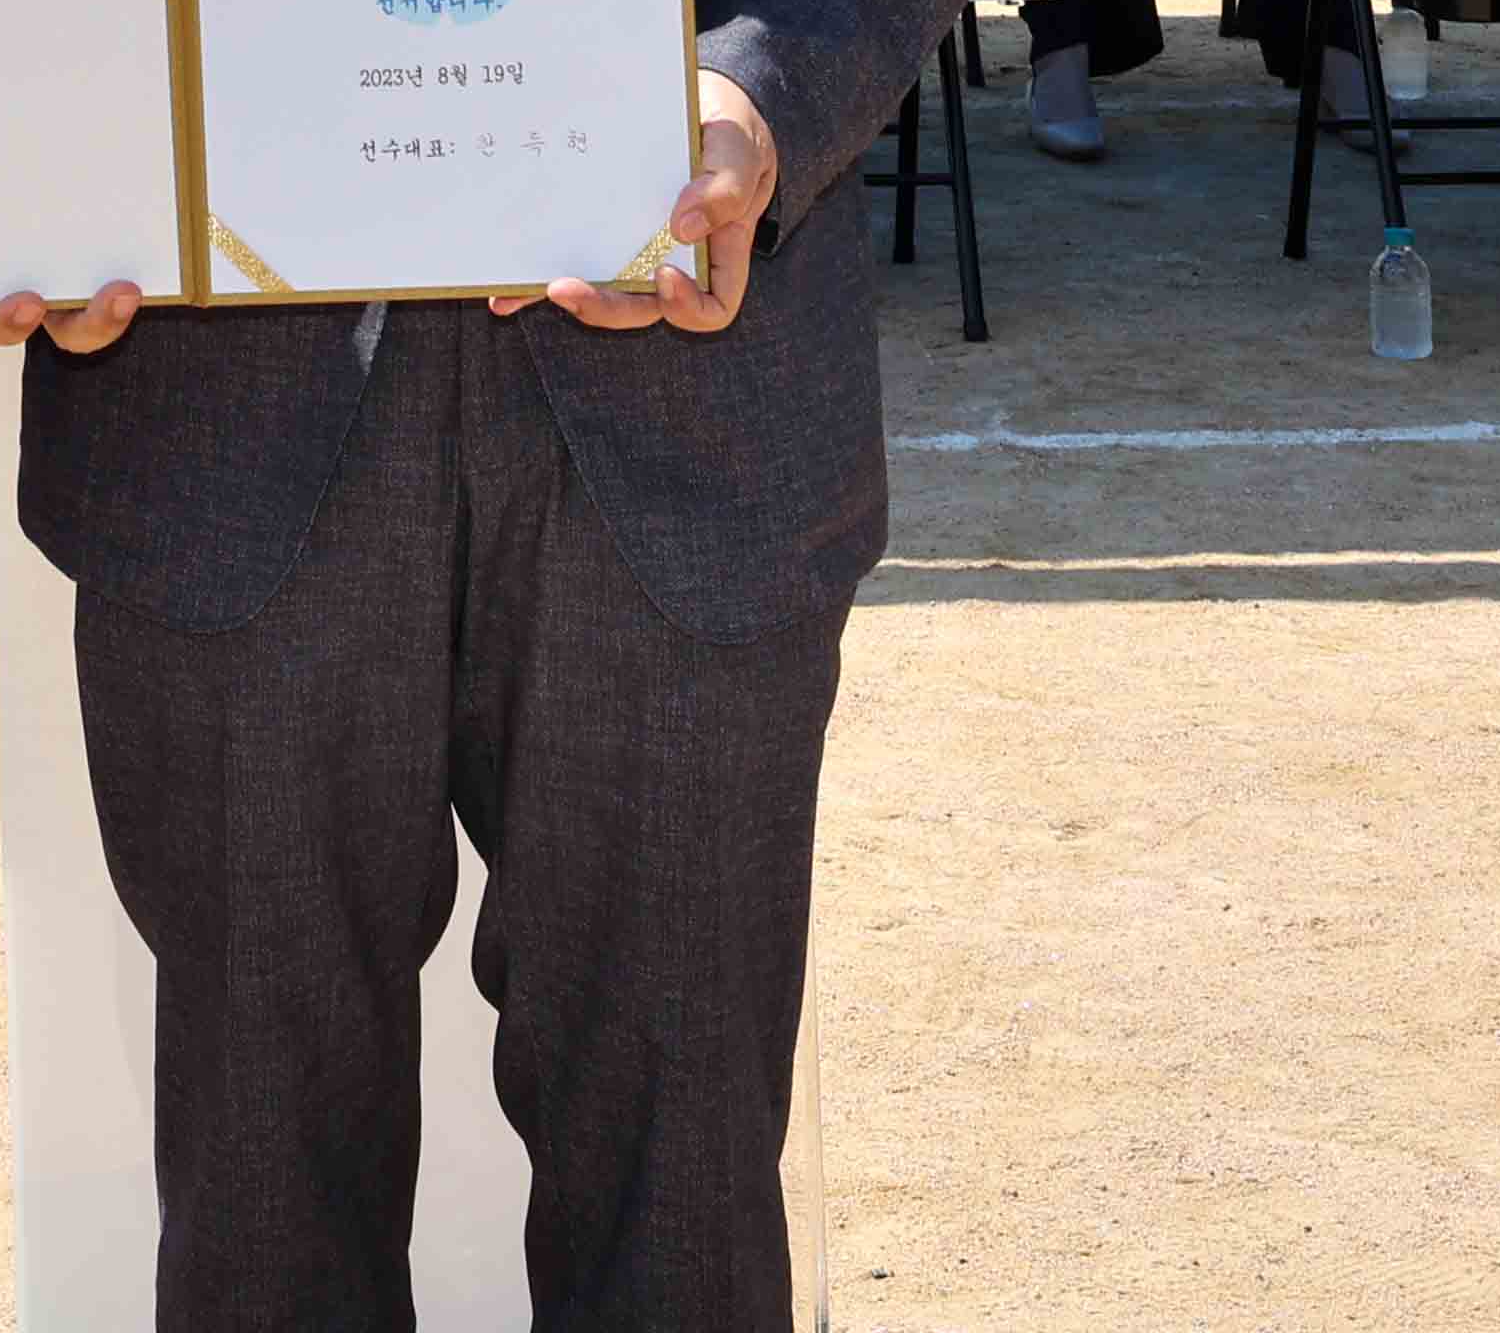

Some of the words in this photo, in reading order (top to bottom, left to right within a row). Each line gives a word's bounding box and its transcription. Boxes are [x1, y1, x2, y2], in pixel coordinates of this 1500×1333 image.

[359, 64, 425, 89] 2023년
[437, 63, 468, 88] 8월
[481, 61, 524, 86] 19일
[359, 137, 457, 163] 선수대표:
